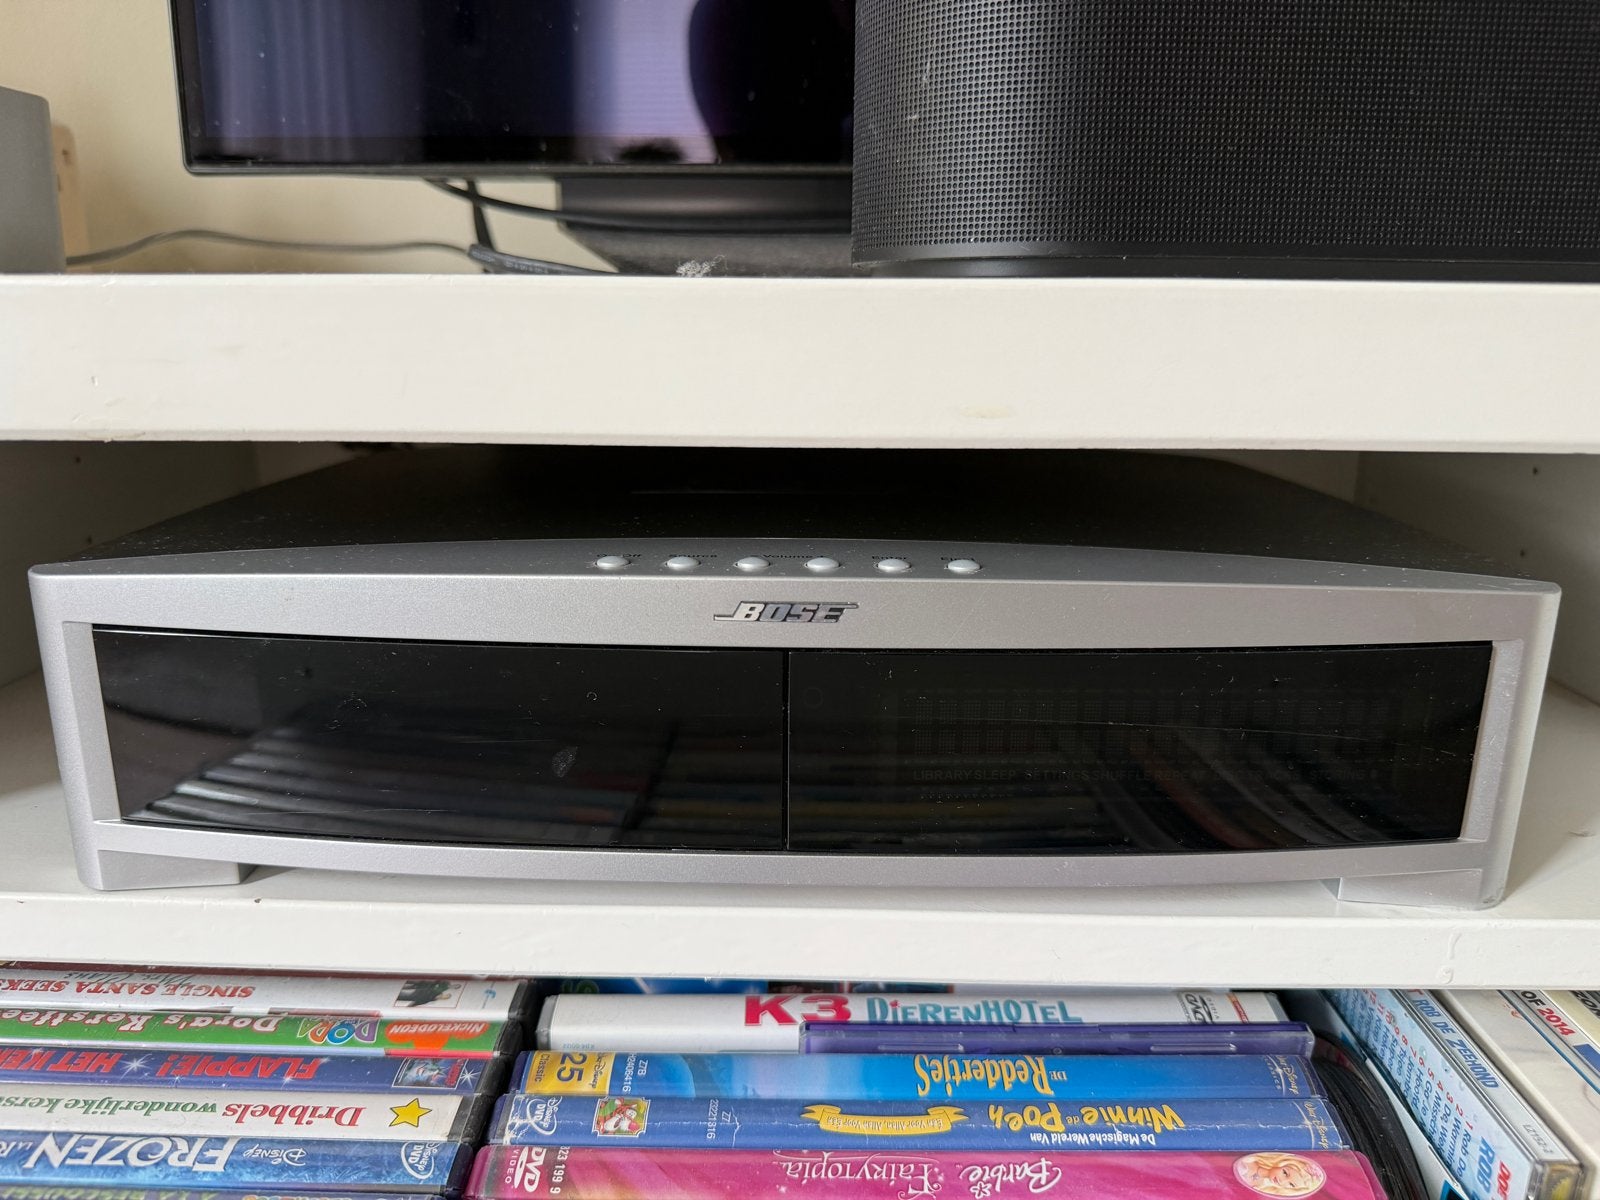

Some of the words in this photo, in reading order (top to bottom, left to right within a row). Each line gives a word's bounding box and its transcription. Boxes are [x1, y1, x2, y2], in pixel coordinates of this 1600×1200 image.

[720, 601, 856, 622] BOSE
[913, 769, 974, 781] LIBRARY
[76, 982, 160, 995] SANTA
[161, 984, 256, 998] SINGLE
[0, 1009, 152, 1032] Kerstfee
[744, 995, 852, 1026] K3
[1521, 990, 1546, 1006] OF
[1537, 1008, 1576, 1036] 2014
[162, 1013, 285, 1032] Dora's
[296, 1017, 379, 1044] DORA
[389, 1023, 485, 1034] NICKELODEON
[1402, 1034, 1408, 1046] 8
[1414, 1000, 1442, 1018] ROB
[1432, 1021, 1456, 1034] DE
[1445, 1039, 1499, 1088] ZEEHOND
[1410, 1045, 1417, 1058] 7
[46, 1051, 125, 1073] HET
[156, 1054, 322, 1080] FLAPPIE!
[534, 1053, 550, 1082] Classic
[556, 1052, 587, 1082] 25
[1418, 1056, 1425, 1068] 6
[1427, 1068, 1435, 1080] 5
[1436, 1081, 1444, 1092] 4
[0, 1096, 64, 1114] kers
[64, 1096, 217, 1116] wonderlijke
[1446, 1092, 1454, 1104] 3
[222, 1103, 366, 1127] Dribbels
[532, 1104, 546, 1122] DVD
[988, 1102, 1066, 1133] Poeh
[1080, 1104, 1185, 1133] Winnie
[1456, 1103, 1464, 1117] 2
[844, 1119, 862, 1128] Voor
[907, 1120, 926, 1130] Voor
[1066, 1115, 1080, 1126] de
[1465, 1120, 1474, 1130] 1
[1030, 1132, 1050, 1144] Van
[1051, 1132, 1090, 1144] Wereld
[1090, 1130, 1139, 1144] Magische
[1141, 1133, 1156, 1145] De
[1460, 1128, 1472, 1157] Rob
[22, 1132, 242, 1172] FROZEN
[242, 1144, 307, 1166] Disney
[408, 1144, 424, 1164] DVD
[504, 1148, 520, 1184] VIDEO
[524, 1146, 547, 1193] DVD
[552, 1164, 566, 1182] 199
[780, 1151, 943, 1197] Fairytopia
[1456, 1156, 1467, 1178] De
[1476, 1136, 1496, 1194] ROB
[958, 1158, 1062, 1197] Barbie
